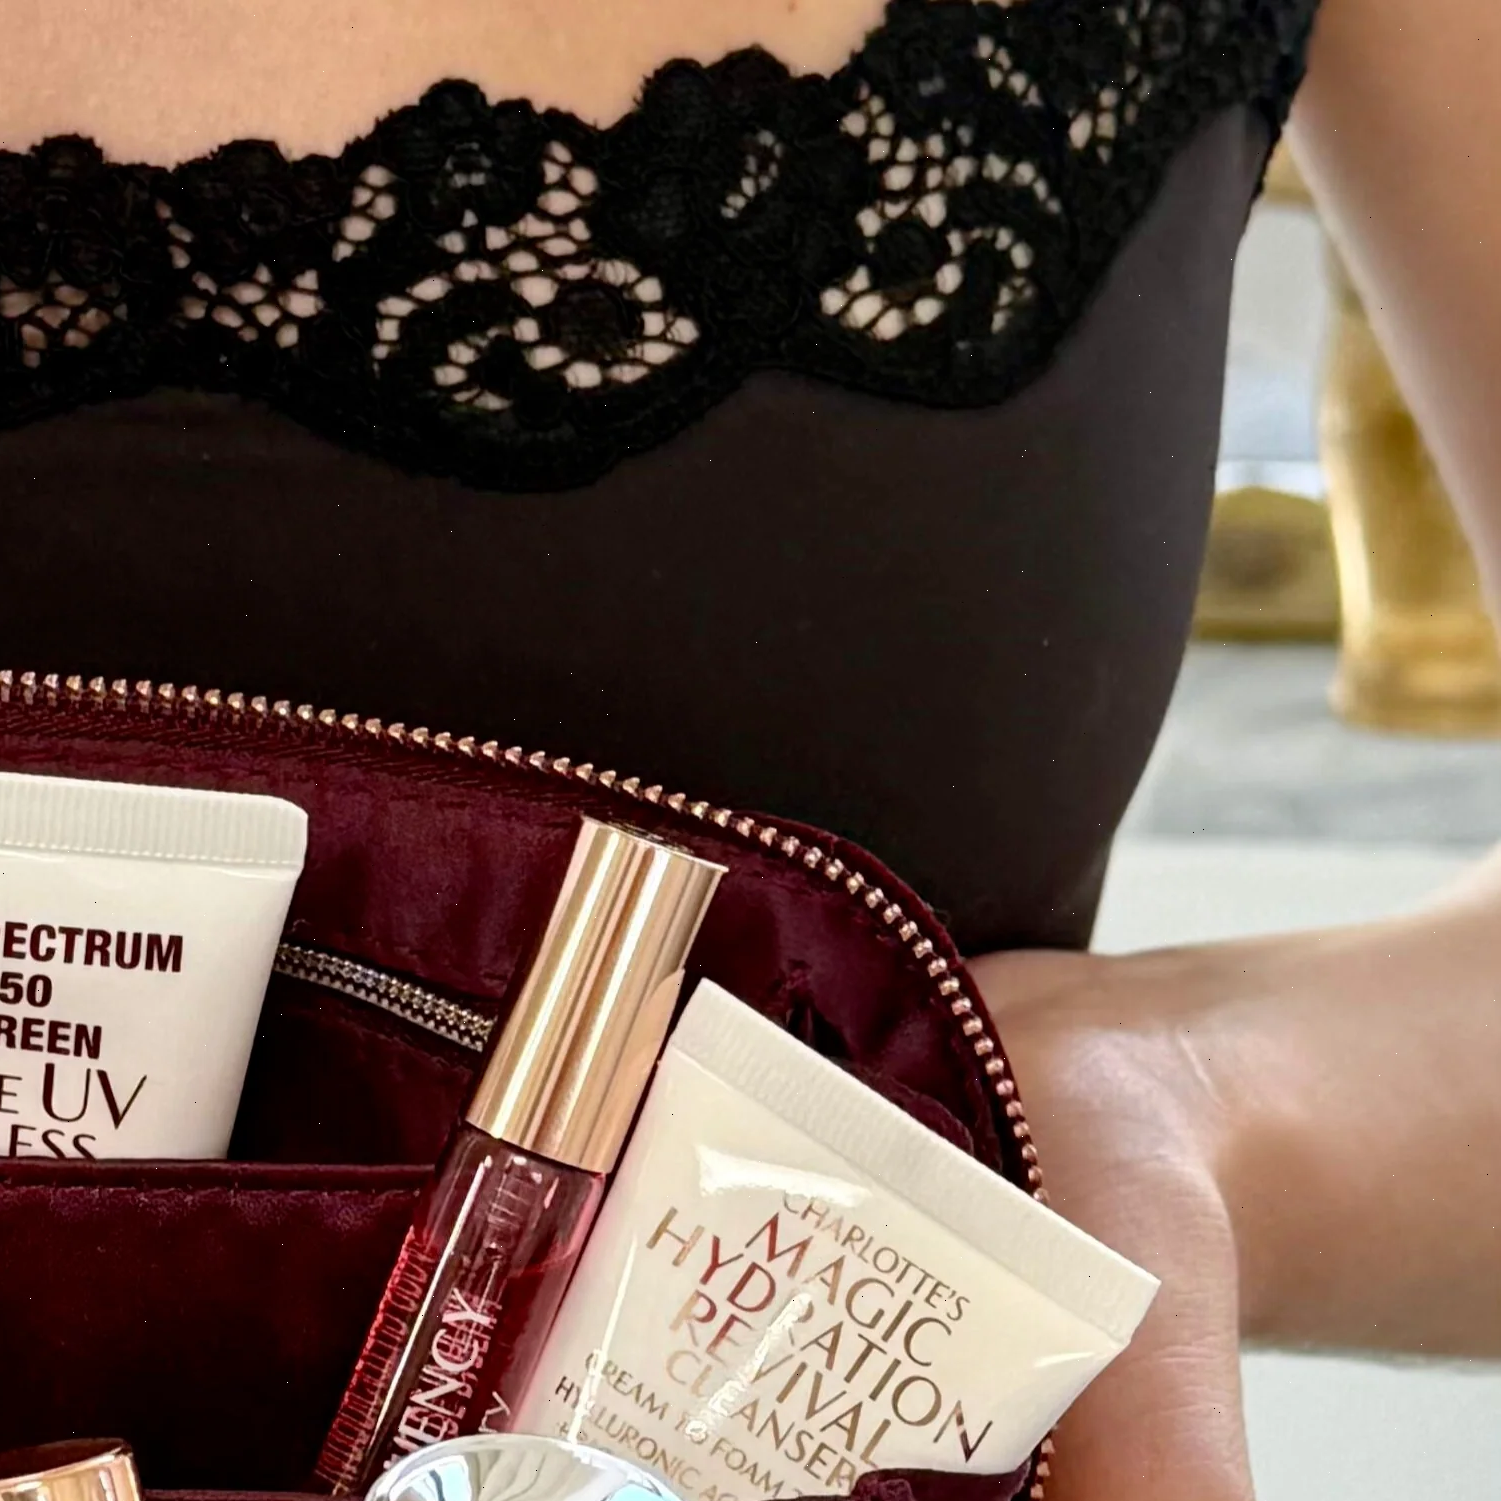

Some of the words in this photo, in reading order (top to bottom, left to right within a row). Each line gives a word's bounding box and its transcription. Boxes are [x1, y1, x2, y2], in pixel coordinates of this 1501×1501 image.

[0, 973, 53, 1008] 50
[42, 1063, 147, 1130] UV
[744, 1212, 952, 1368] MAGIC
[710, 1437, 785, 1498] FOAM
